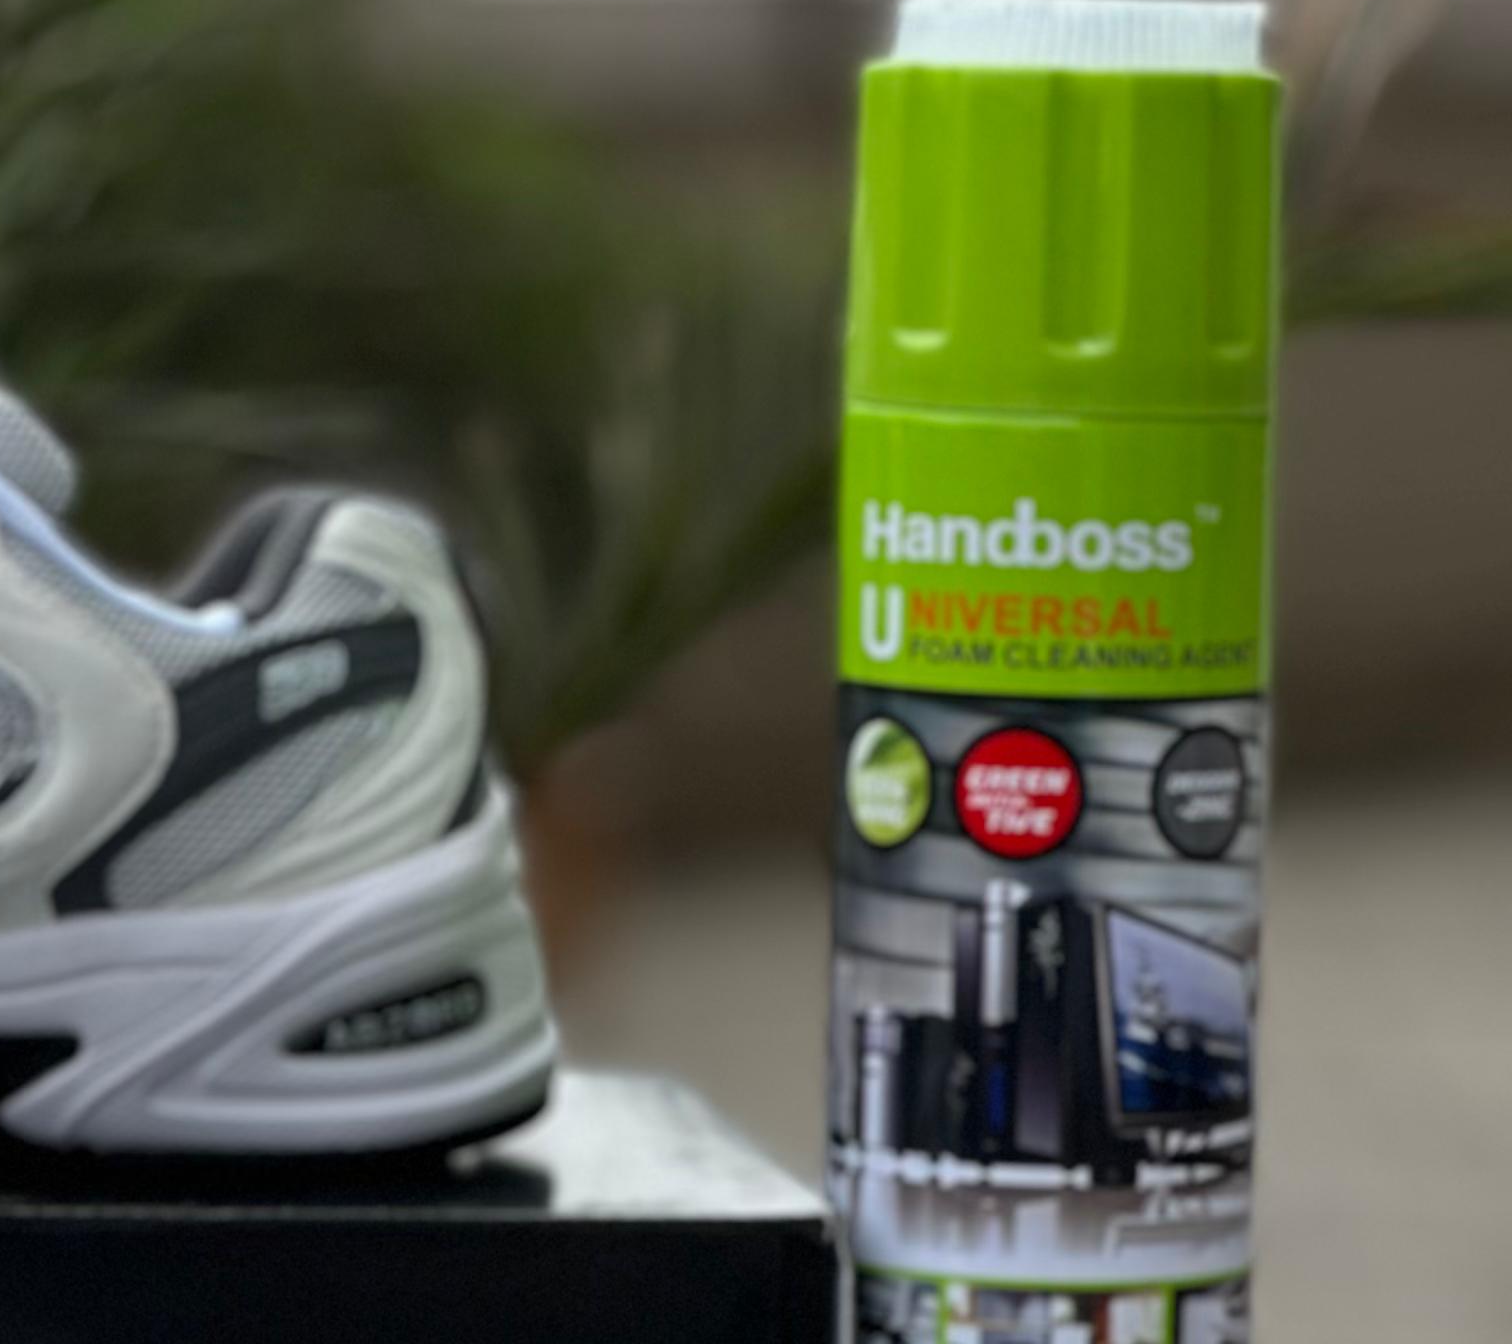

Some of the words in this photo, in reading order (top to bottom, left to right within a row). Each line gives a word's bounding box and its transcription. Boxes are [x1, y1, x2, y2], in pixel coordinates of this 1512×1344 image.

[862, 497, 1194, 570] Handboss
[908, 634, 994, 668] FOAM
[1001, 638, 1172, 674] CLEANING
